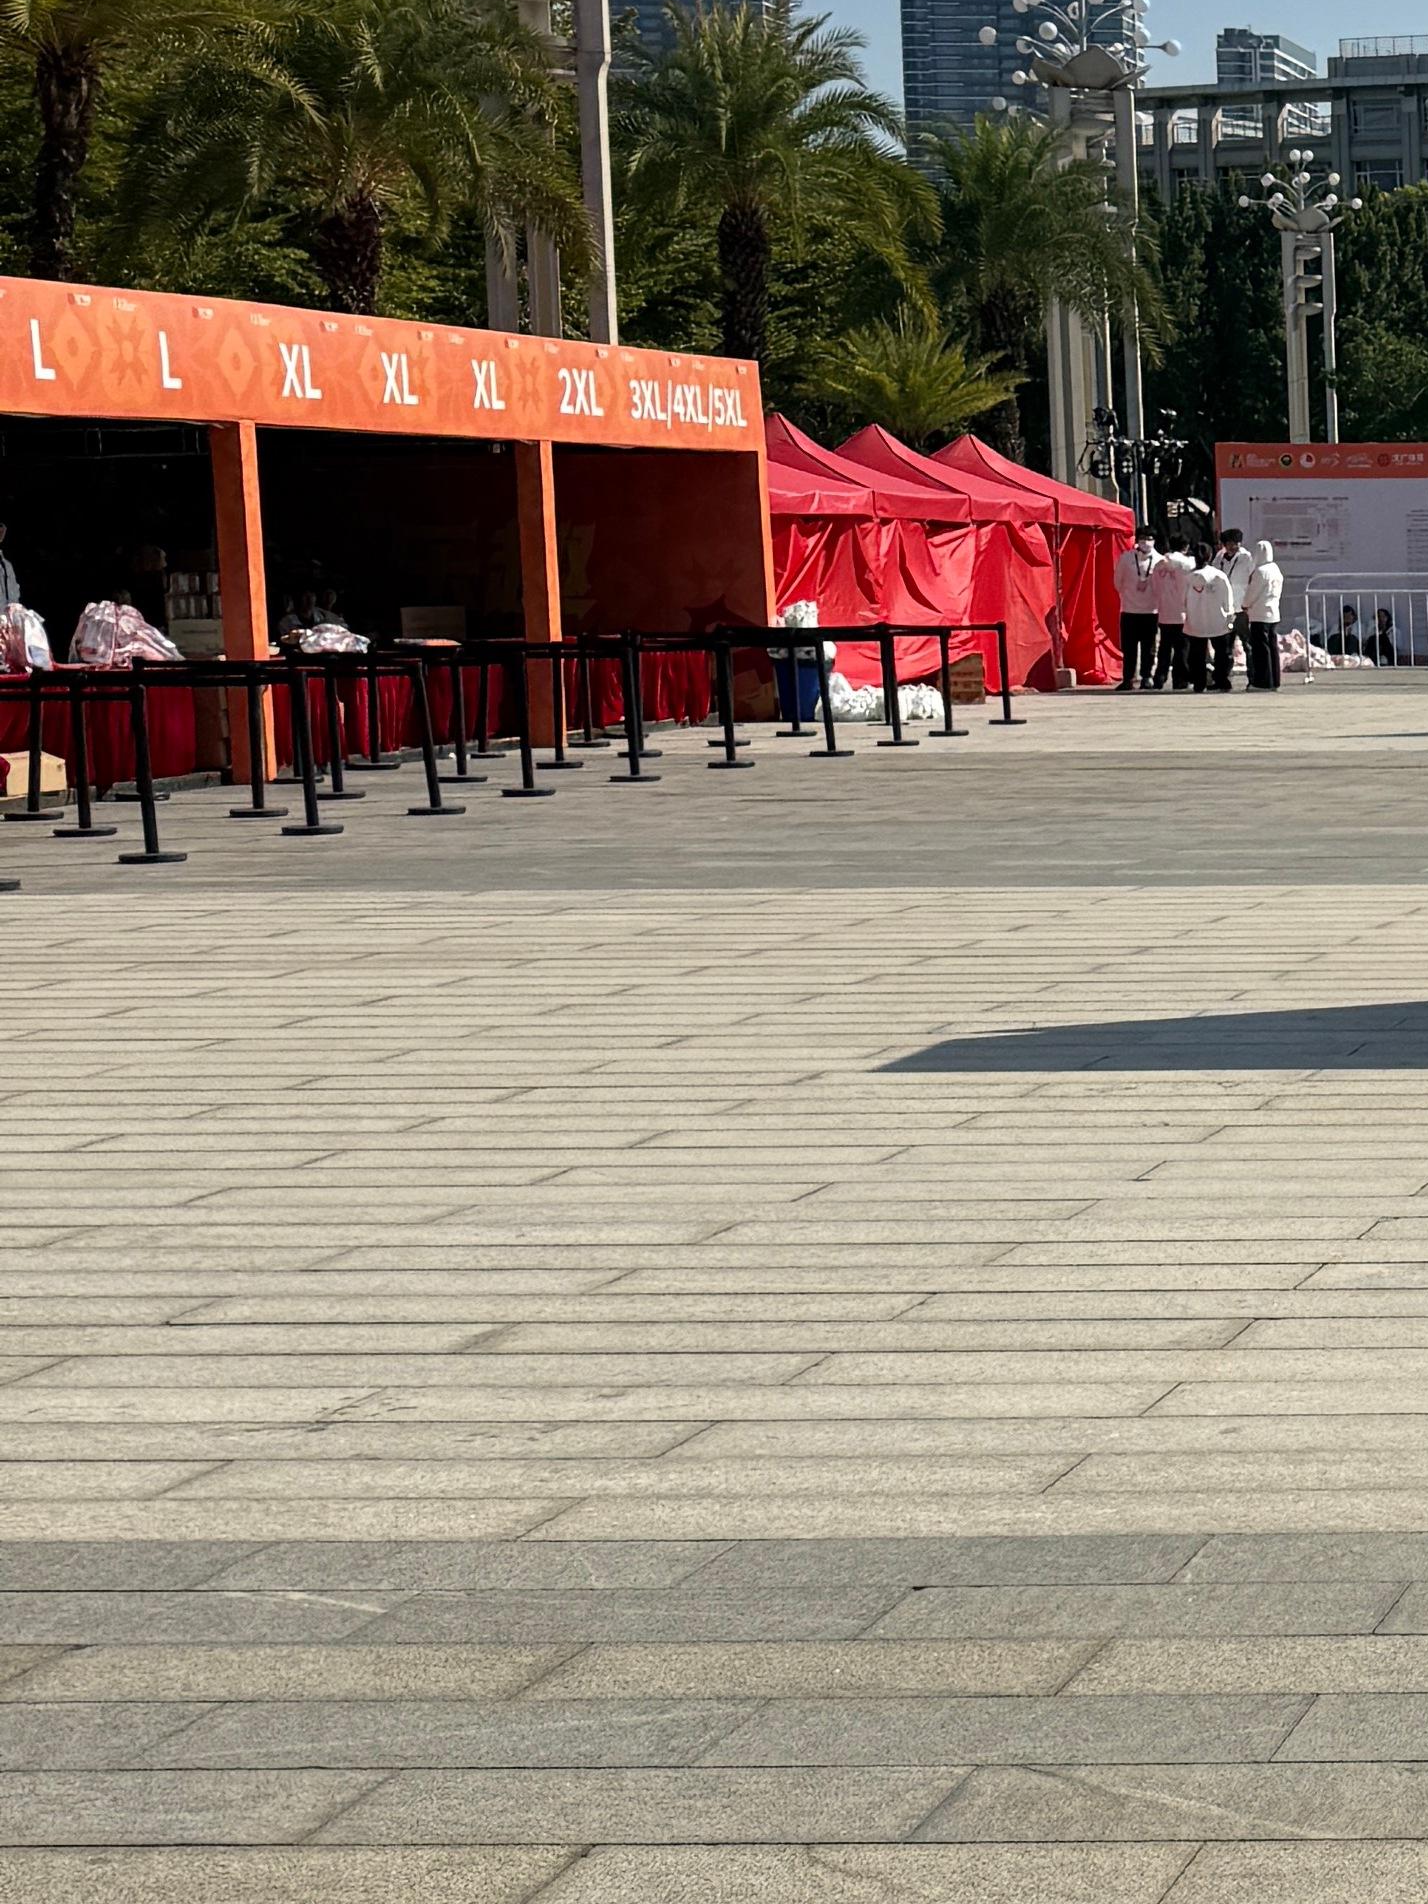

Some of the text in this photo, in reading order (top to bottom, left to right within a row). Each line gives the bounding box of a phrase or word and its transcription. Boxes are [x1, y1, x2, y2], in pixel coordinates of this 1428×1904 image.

[29, 319, 748, 431] L L XL XL XL 2XL 3XL/4XL/5XL
